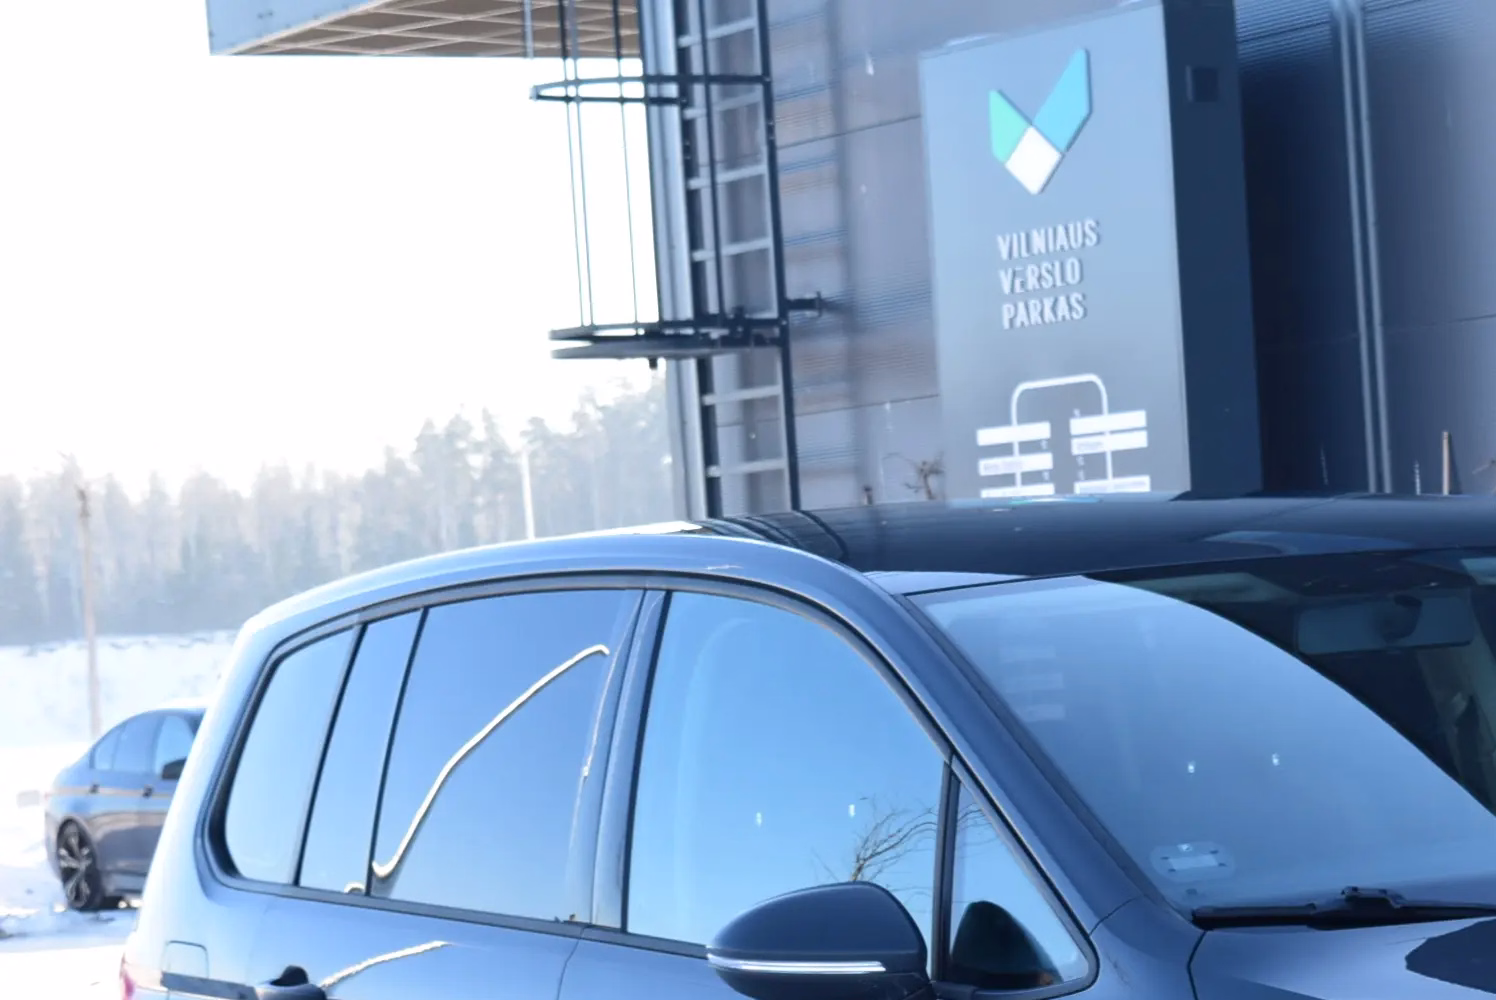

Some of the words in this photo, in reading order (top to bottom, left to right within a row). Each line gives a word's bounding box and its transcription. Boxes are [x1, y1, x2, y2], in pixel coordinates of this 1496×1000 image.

[998, 218, 1098, 260] VILNIAUS
[1000, 257, 1081, 295] VERSLO
[1003, 292, 1085, 330] PARKAS
